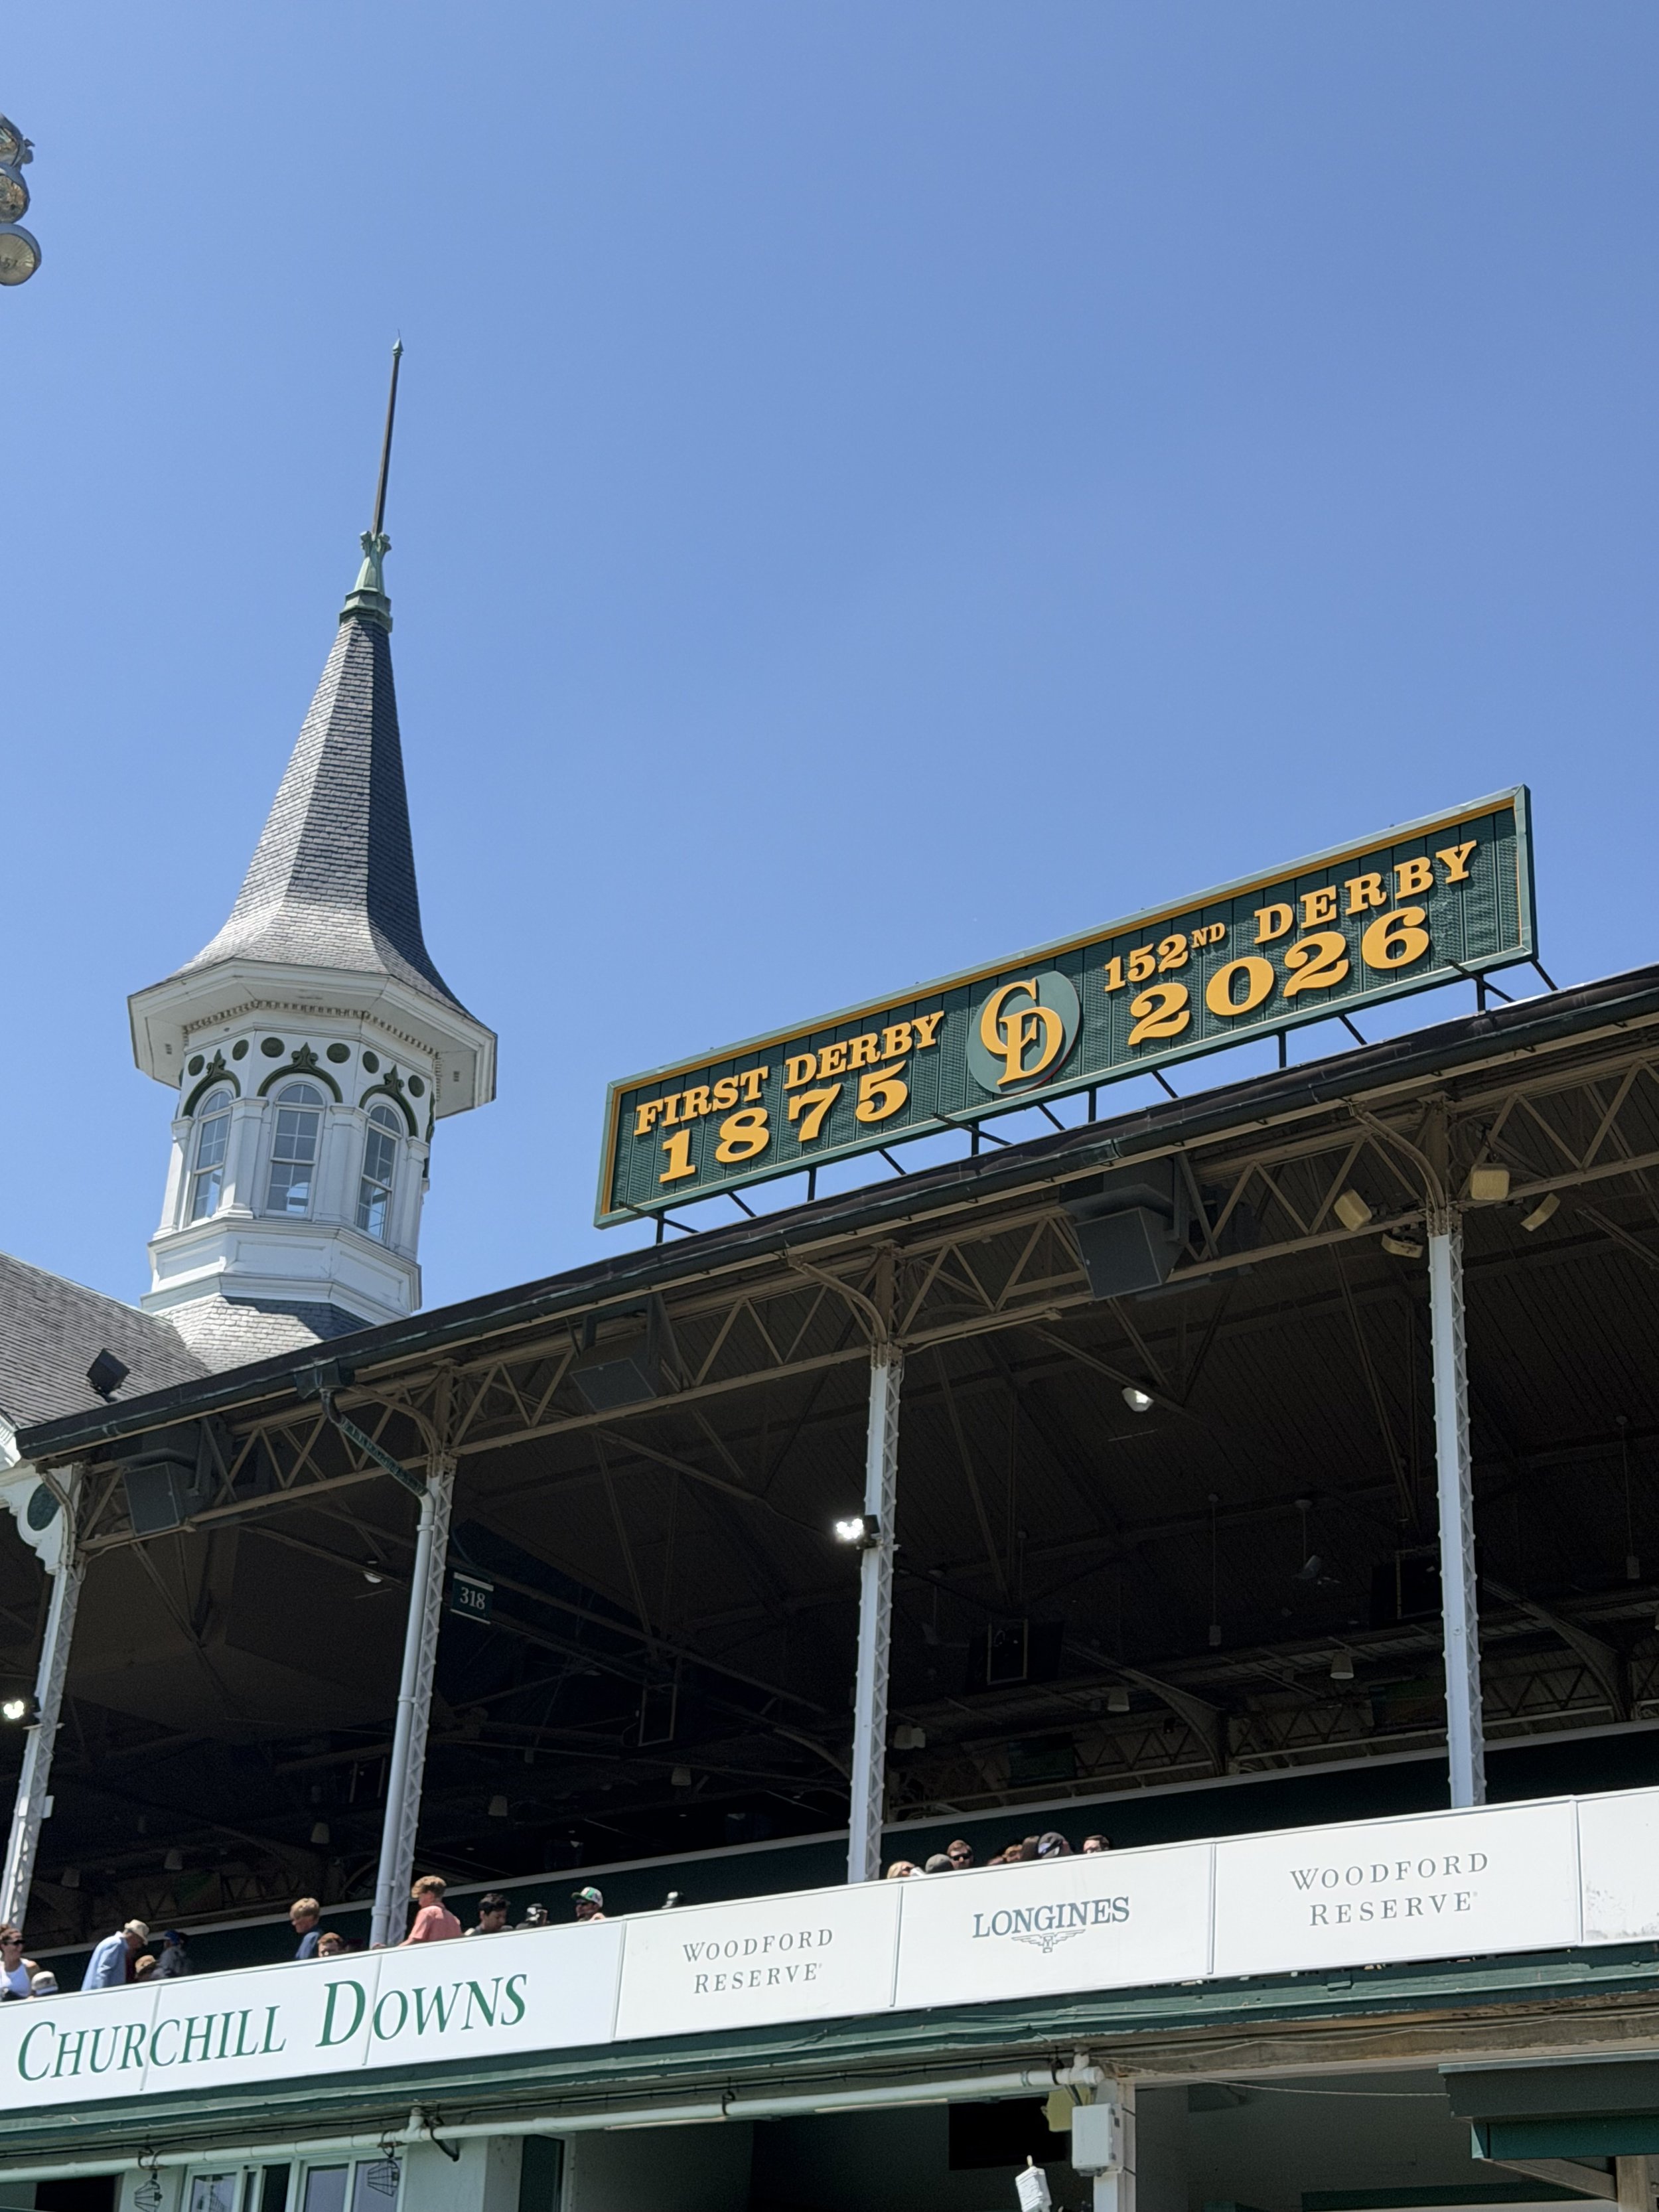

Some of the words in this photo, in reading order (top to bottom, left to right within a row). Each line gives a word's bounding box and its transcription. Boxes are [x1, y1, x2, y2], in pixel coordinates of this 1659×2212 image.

[1105, 923, 1225, 992] 152ND
[1254, 840, 1477, 944] DERBY
[1128, 907, 1429, 1045] 2026
[634, 1066, 768, 1135] FIRST
[784, 1011, 944, 1090] DERBY
[660, 1061, 908, 1183] 1875
[460, 1586, 486, 1609] 318
[972, 1896, 1130, 1939] LONGINES
[1289, 1852, 1488, 1891] WOODFORD
[682, 1929, 833, 1962] WOODFORD
[18, 2005, 287, 2081] CHURCHILL
[315, 1974, 528, 2047] DOWNS
